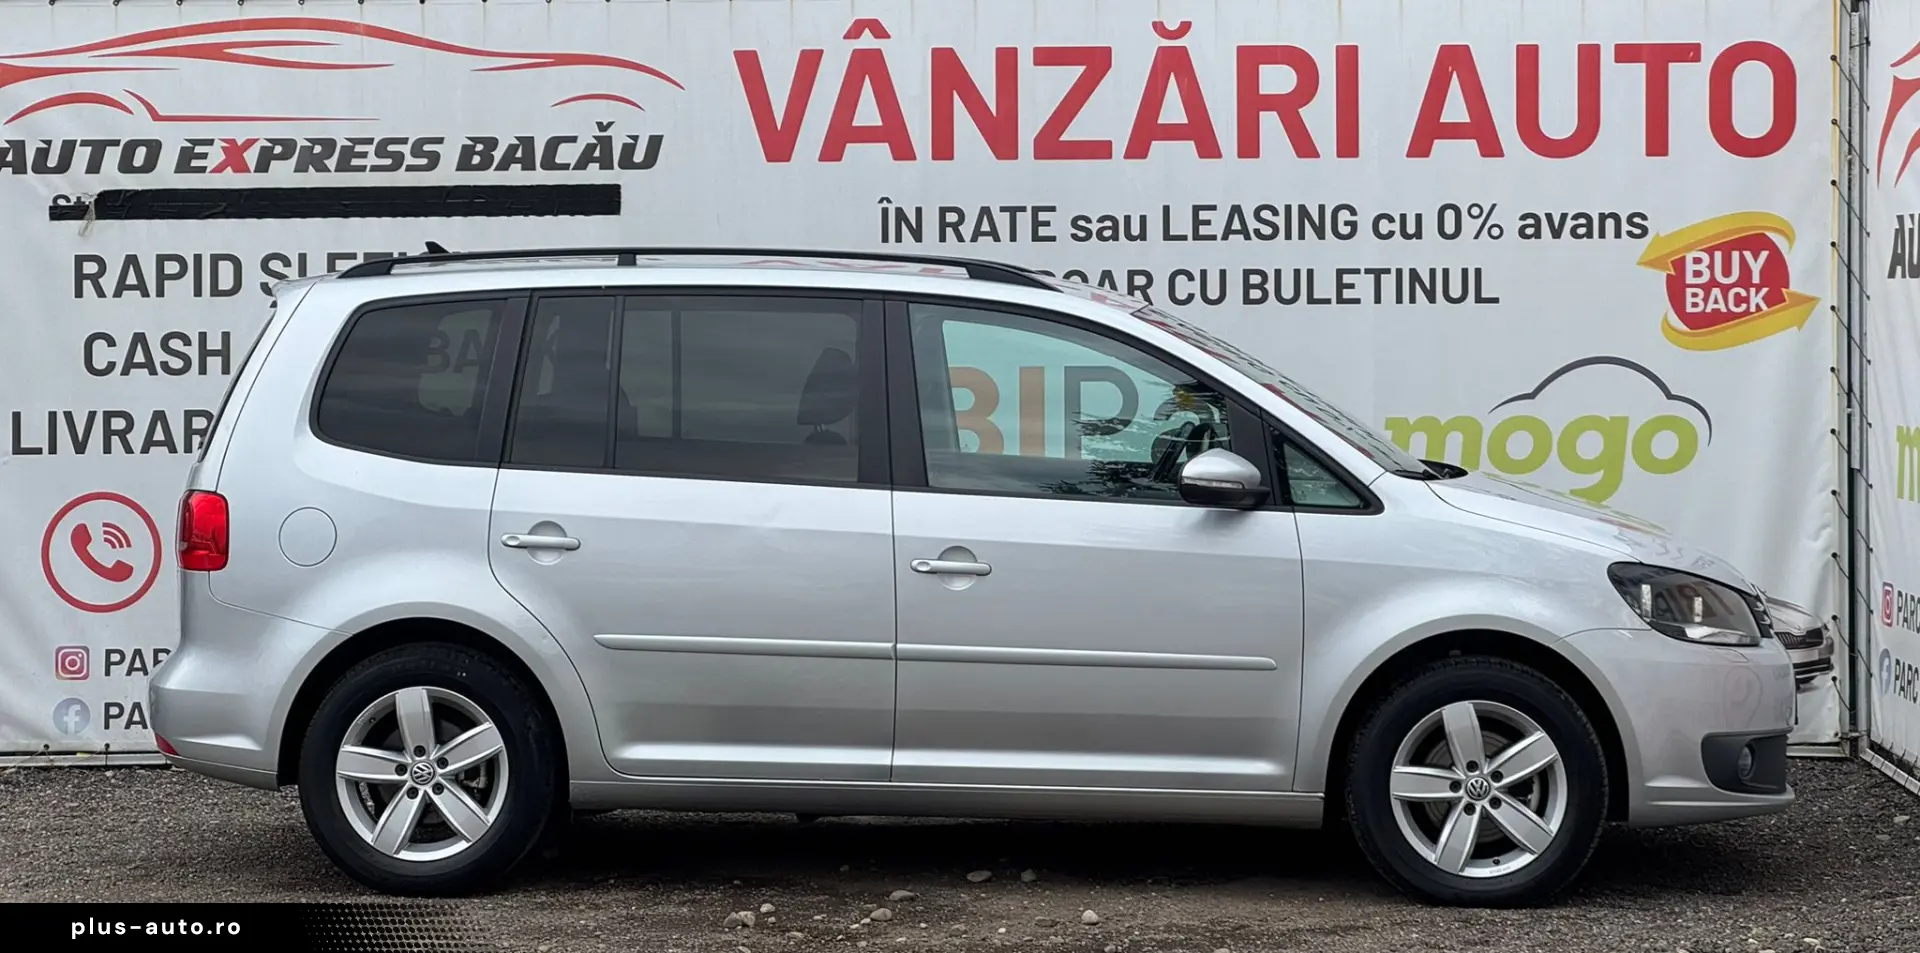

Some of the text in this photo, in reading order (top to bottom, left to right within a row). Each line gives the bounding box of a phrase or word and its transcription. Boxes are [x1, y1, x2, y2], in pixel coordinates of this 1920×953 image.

[734, 18, 1798, 163] VÂNZĂRI AUTO
[0, 121, 665, 175] AUTO EXPRESS BACĂU
[878, 197, 1650, 244] ÎN RATE sau LEASING cu 0% avans
[74, 254, 244, 299] RAPID
[1167, 269, 1228, 307] CU
[1243, 267, 1501, 306] BULETINUL
[1685, 250, 1771, 285] BUY
[1685, 287, 1768, 314] BACK
[83, 331, 232, 377] CASH
[1384, 414, 1699, 503] mogo
